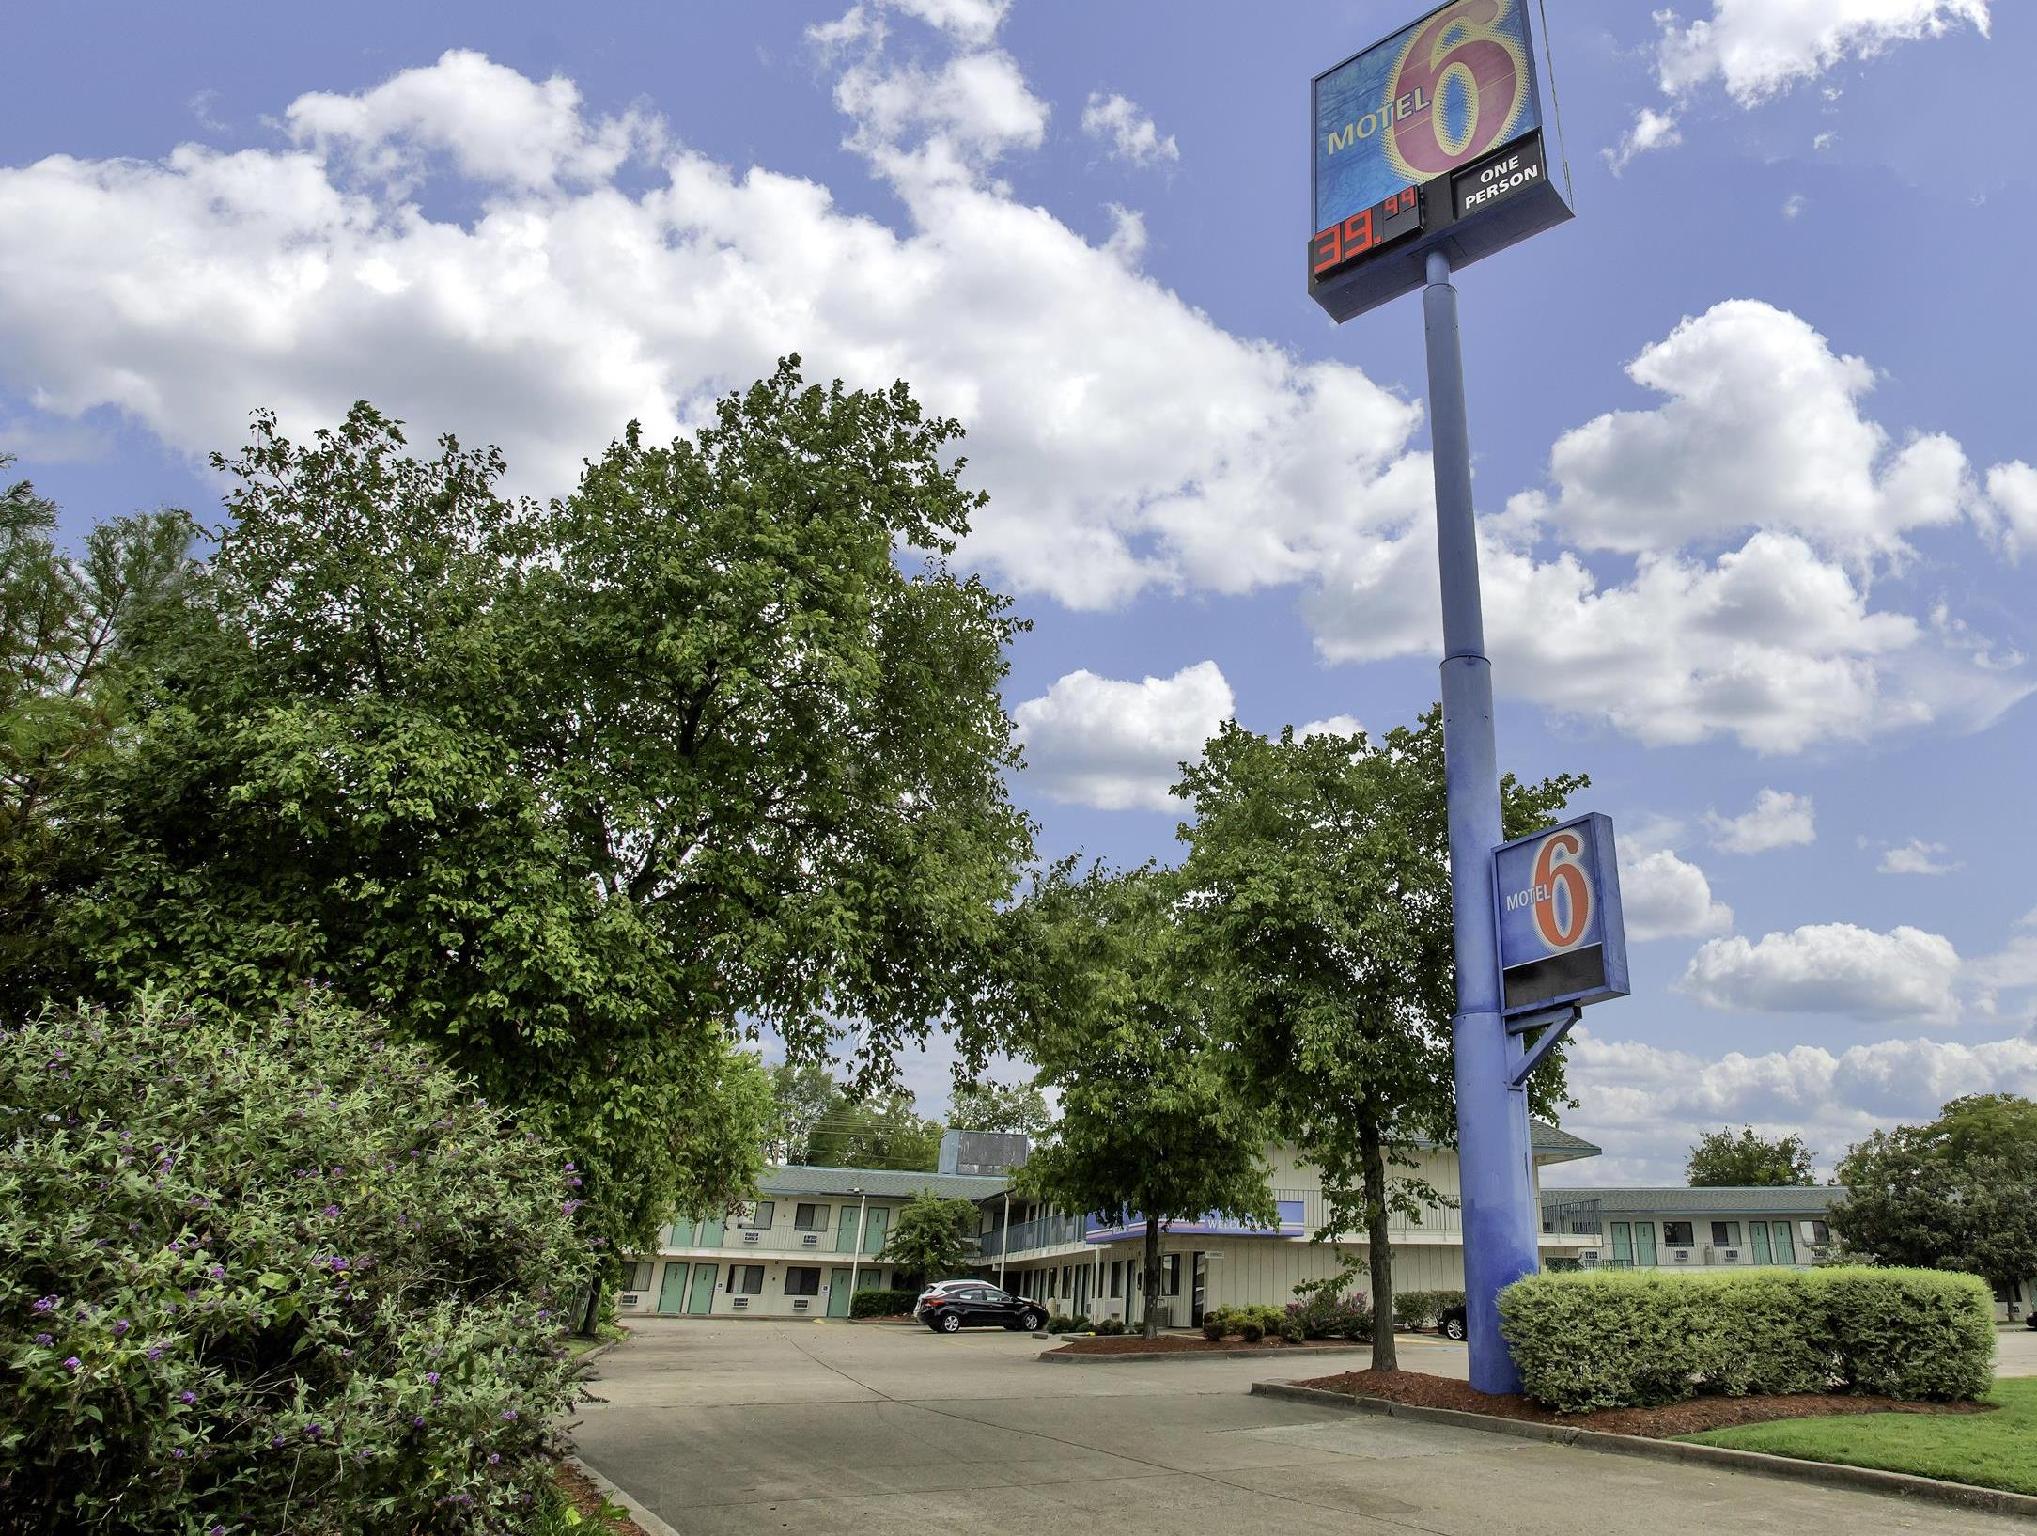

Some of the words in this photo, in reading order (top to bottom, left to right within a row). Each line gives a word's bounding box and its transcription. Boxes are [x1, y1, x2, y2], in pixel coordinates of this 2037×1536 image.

[1328, 86, 1432, 156] MOTEL
[1388, 0, 1519, 176] 6
[1465, 164, 1538, 209] PERSON
[1481, 155, 1519, 183] ONE
[1506, 883, 1551, 912] MOTEL
[1533, 833, 1590, 948] 6
